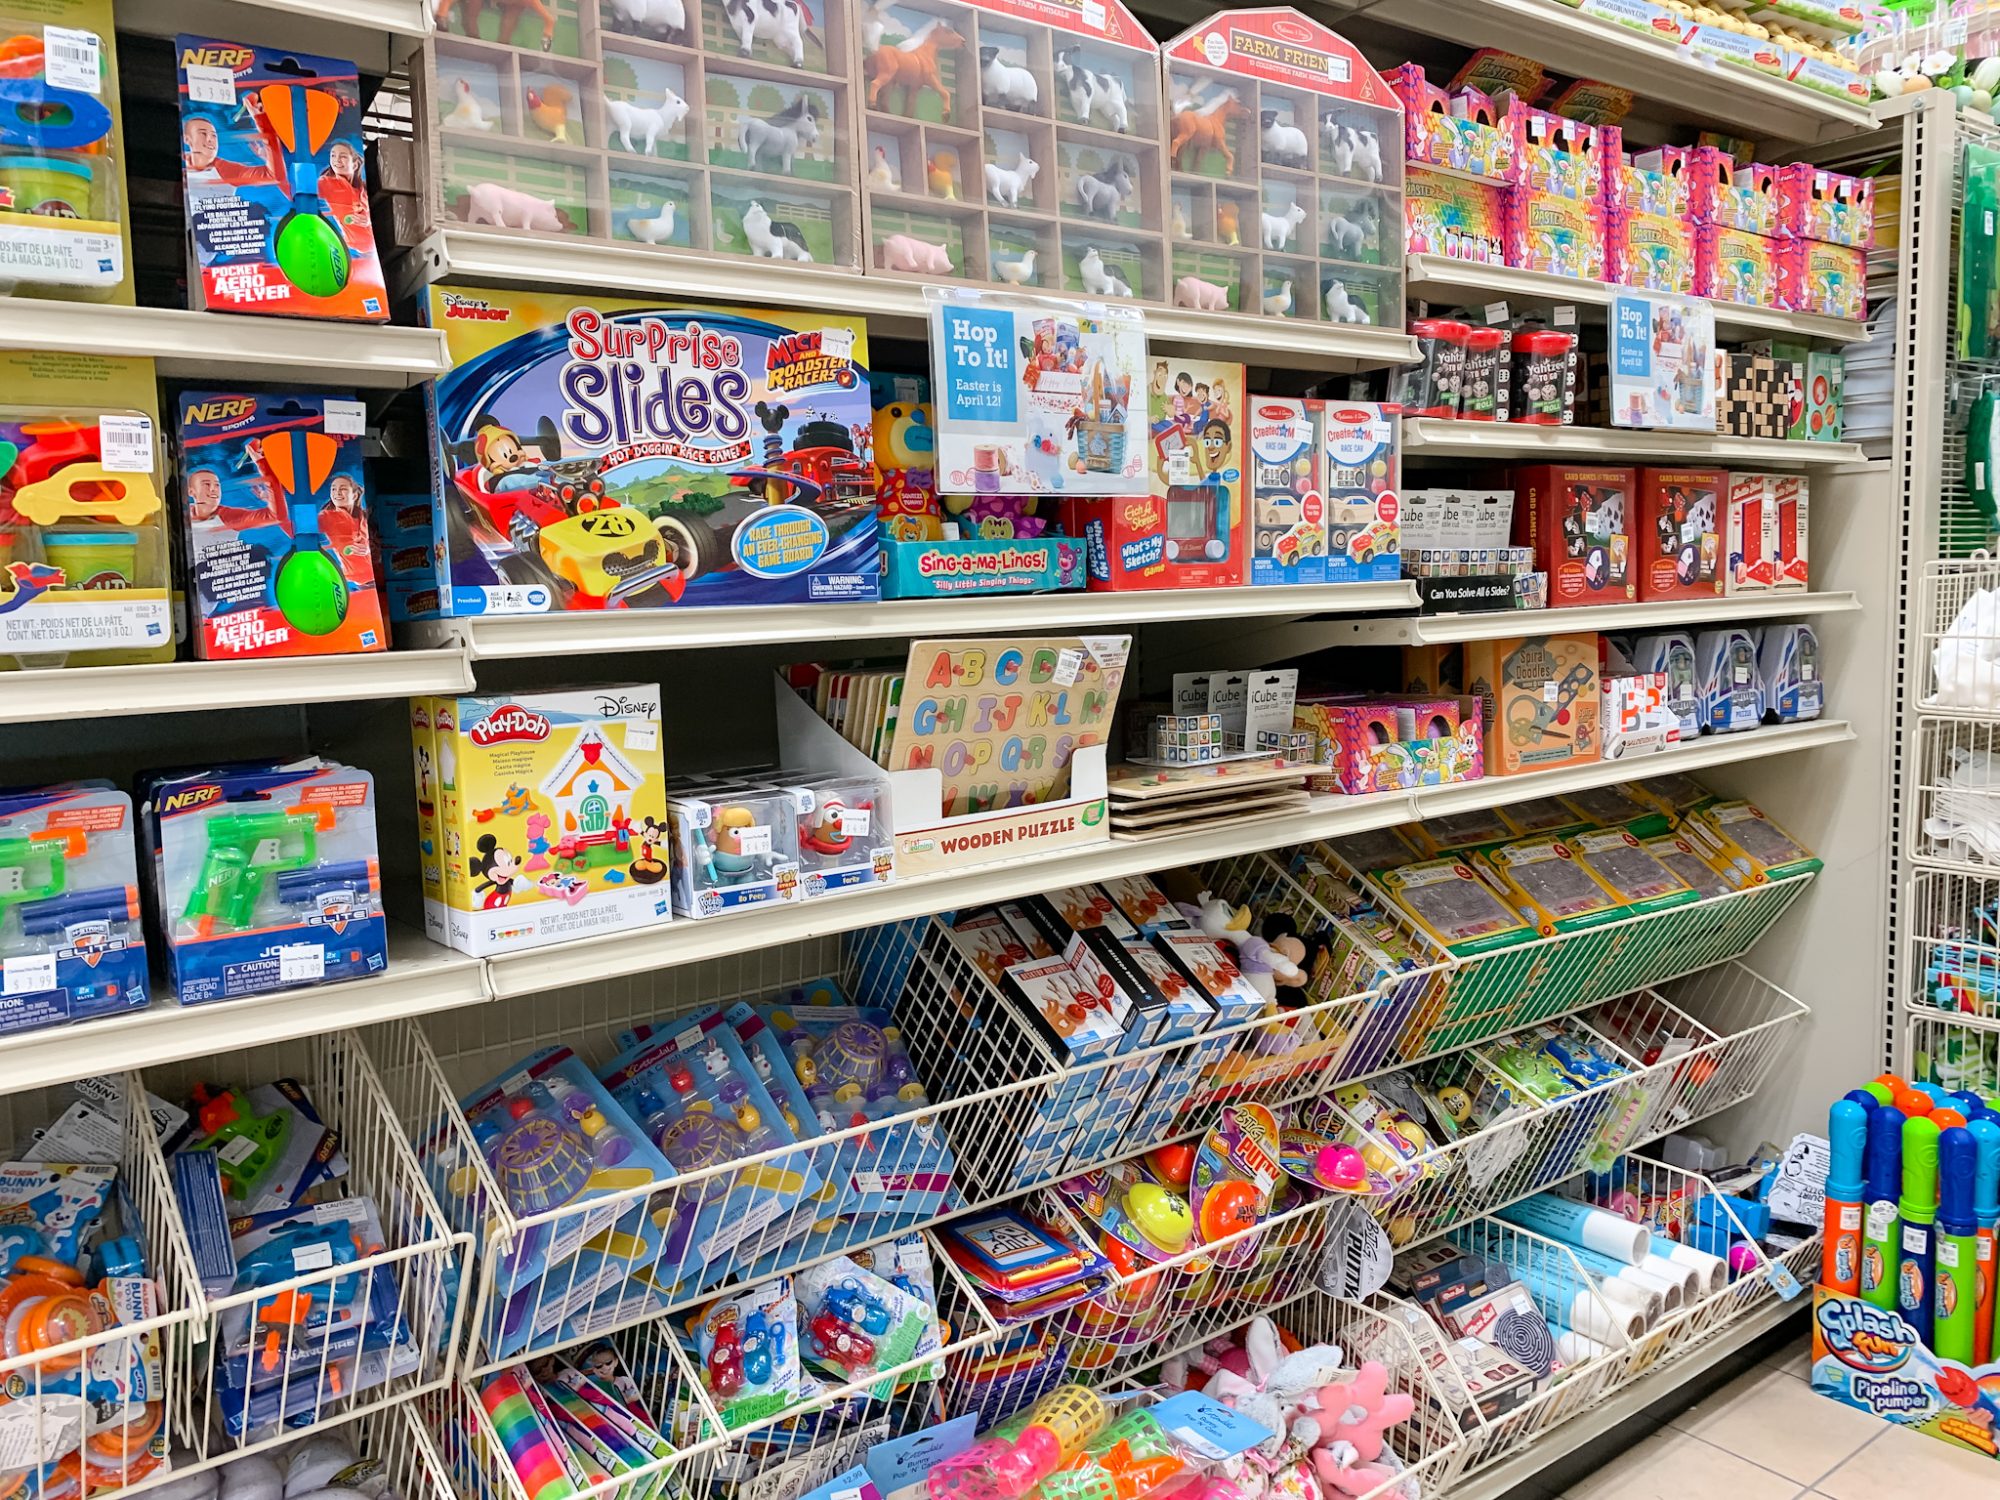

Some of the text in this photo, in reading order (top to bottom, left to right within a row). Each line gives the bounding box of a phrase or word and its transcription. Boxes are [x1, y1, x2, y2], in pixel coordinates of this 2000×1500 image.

[180, 48, 253, 69] NERF
[1234, 35, 1279, 59] FARM
[1284, 48, 1329, 71] FRIEN
[12, 242, 28, 253] NET
[29, 244, 40, 255] DE
[42, 246, 52, 256] LA
[19, 254, 42, 266] MASA
[211, 264, 259, 279] POCKET
[214, 274, 265, 295] AERO
[234, 284, 290, 303] FLYER
[1621, 306, 1643, 326] Hop
[953, 319, 998, 347] Hop
[1621, 324, 1647, 341] To It!
[767, 332, 823, 369] MICK
[953, 345, 1008, 368] To It!
[768, 356, 848, 390] ROADSTER
[1527, 361, 1566, 376] Yahtzee
[784, 368, 837, 391] RACERS
[956, 378, 1001, 393] Easter is
[565, 363, 748, 444] Slides
[956, 393, 1001, 408] April 12!
[1476, 400, 1493, 410] ROLL
[1543, 403, 1561, 413] ROLL
[184, 398, 256, 425] NERF
[221, 415, 256, 431] SPORTS
[1253, 424, 1281, 440] Created
[1327, 427, 1356, 442] Created
[608, 443, 741, 465] HOT DOGGIN' RACE GAME!
[1578, 473, 1597, 481] GAMES
[1602, 474, 1620, 482] TRICKS
[590, 516, 633, 537] 28
[749, 520, 811, 541] RACE THROUGH
[743, 531, 823, 557] AN EVER-CHANGING
[1122, 535, 1164, 558] What's My
[758, 546, 814, 568] GAME BOARD!
[1126, 548, 1161, 569] Sketch?
[1144, 563, 1166, 577] Game
[828, 575, 864, 585] WARNING:
[955, 577, 1007, 588] Little Singing
[1430, 585, 1510, 600] Can You Solve All 6 Sides?
[6, 614, 122, 630] NET POIDS NET DE LA PÂTE
[212, 609, 260, 629] POCKET
[7, 629, 31, 641] CONT.
[50, 628, 60, 639] DE
[61, 628, 70, 639] LA
[72, 627, 94, 639] MASA
[214, 620, 265, 647] AERO
[233, 628, 289, 653] FLYER
[1519, 647, 1546, 665] Spiral
[1516, 664, 1550, 679] Doodles
[1177, 689, 1207, 703] iCube
[1212, 688, 1240, 703] iCube
[1251, 688, 1278, 703] iCube
[1484, 692, 1494, 723] Spiral
[473, 709, 547, 742] Play-Doh
[165, 786, 221, 811] NERF
[941, 816, 1075, 855] WOODEN PUZZLE
[873, 854, 893, 867] TOY
[776, 870, 796, 882] TOY
[879, 873, 888, 882] 4
[749, 893, 767, 902] Peep
[782, 889, 792, 900] 4
[309, 910, 367, 925] ELITE
[563, 912, 579, 921] POIDS
[580, 909, 590, 919] NET
[590, 908, 598, 917] DE
[598, 907, 605, 916] LA
[568, 917, 599, 930] DE LA MASA
[489, 929, 496, 940] 5
[58, 939, 126, 960] ELITE
[241, 960, 280, 972] CAUTION:
[1020, 963, 1069, 980] DESKTOP BOWLING
[1108, 949, 1147, 994] DESKTOP BOWLING
[182, 984, 195, 993] AGE
[182, 991, 213, 1001] IDADE 8+
[79, 1078, 120, 1101] BUNNY
[319, 1132, 338, 1163] NERF
[0, 1176, 47, 1187] BUNNY
[1343, 1233, 1363, 1299] PUTTY
[1817, 1299, 1916, 1350] Splash
[1855, 1377, 1919, 1399] Pipeline
[1876, 1395, 1928, 1413] pumper
[907, 1457, 930, 1469] Bunny
[921, 1458, 943, 1471] Catch
[843, 1470, 864, 1485] $2.99
[892, 1471, 908, 1480] Pop
